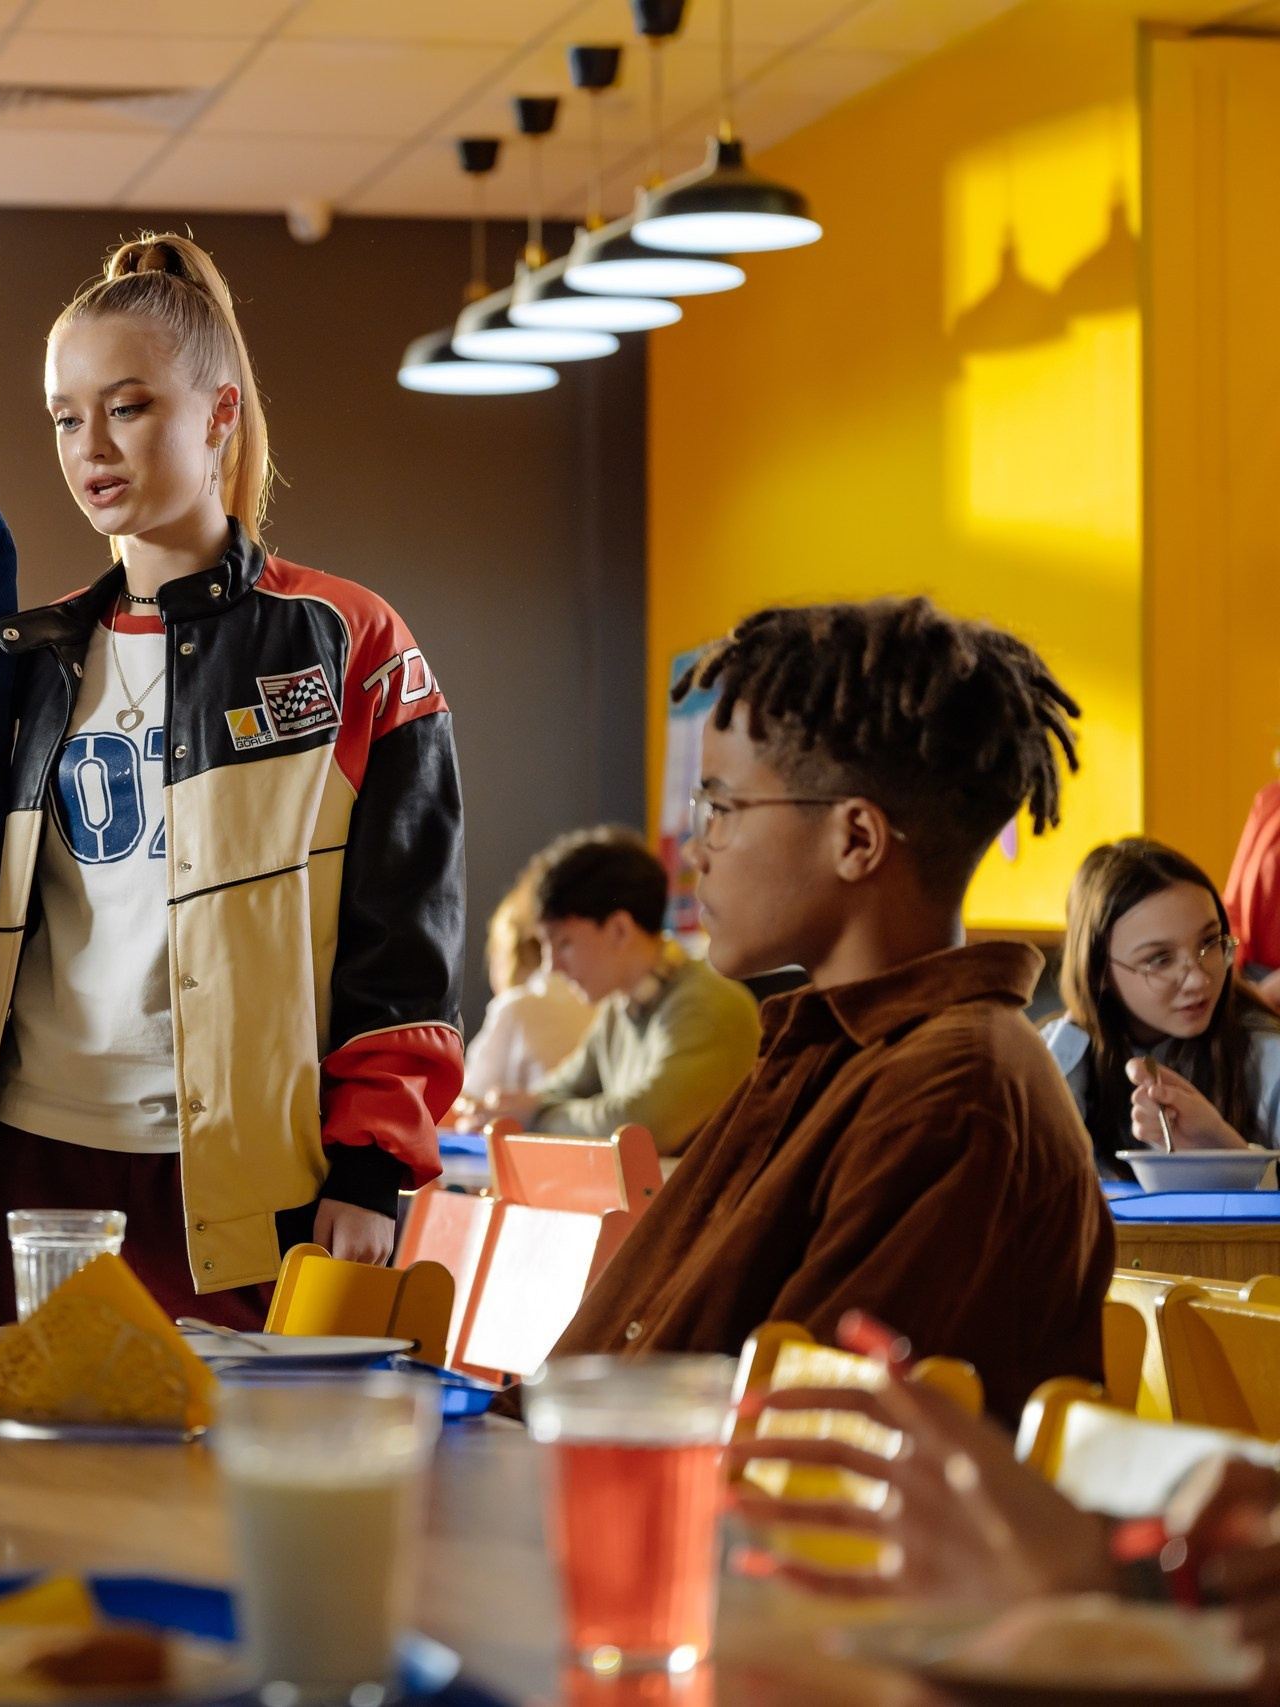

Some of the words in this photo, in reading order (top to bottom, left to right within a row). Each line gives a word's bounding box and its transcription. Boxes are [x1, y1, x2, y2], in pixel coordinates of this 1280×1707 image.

[361, 647, 441, 718] TO
[315, 709, 333, 724] UP
[236, 734, 273, 749] GOALS
[47, 726, 166, 865] 0
